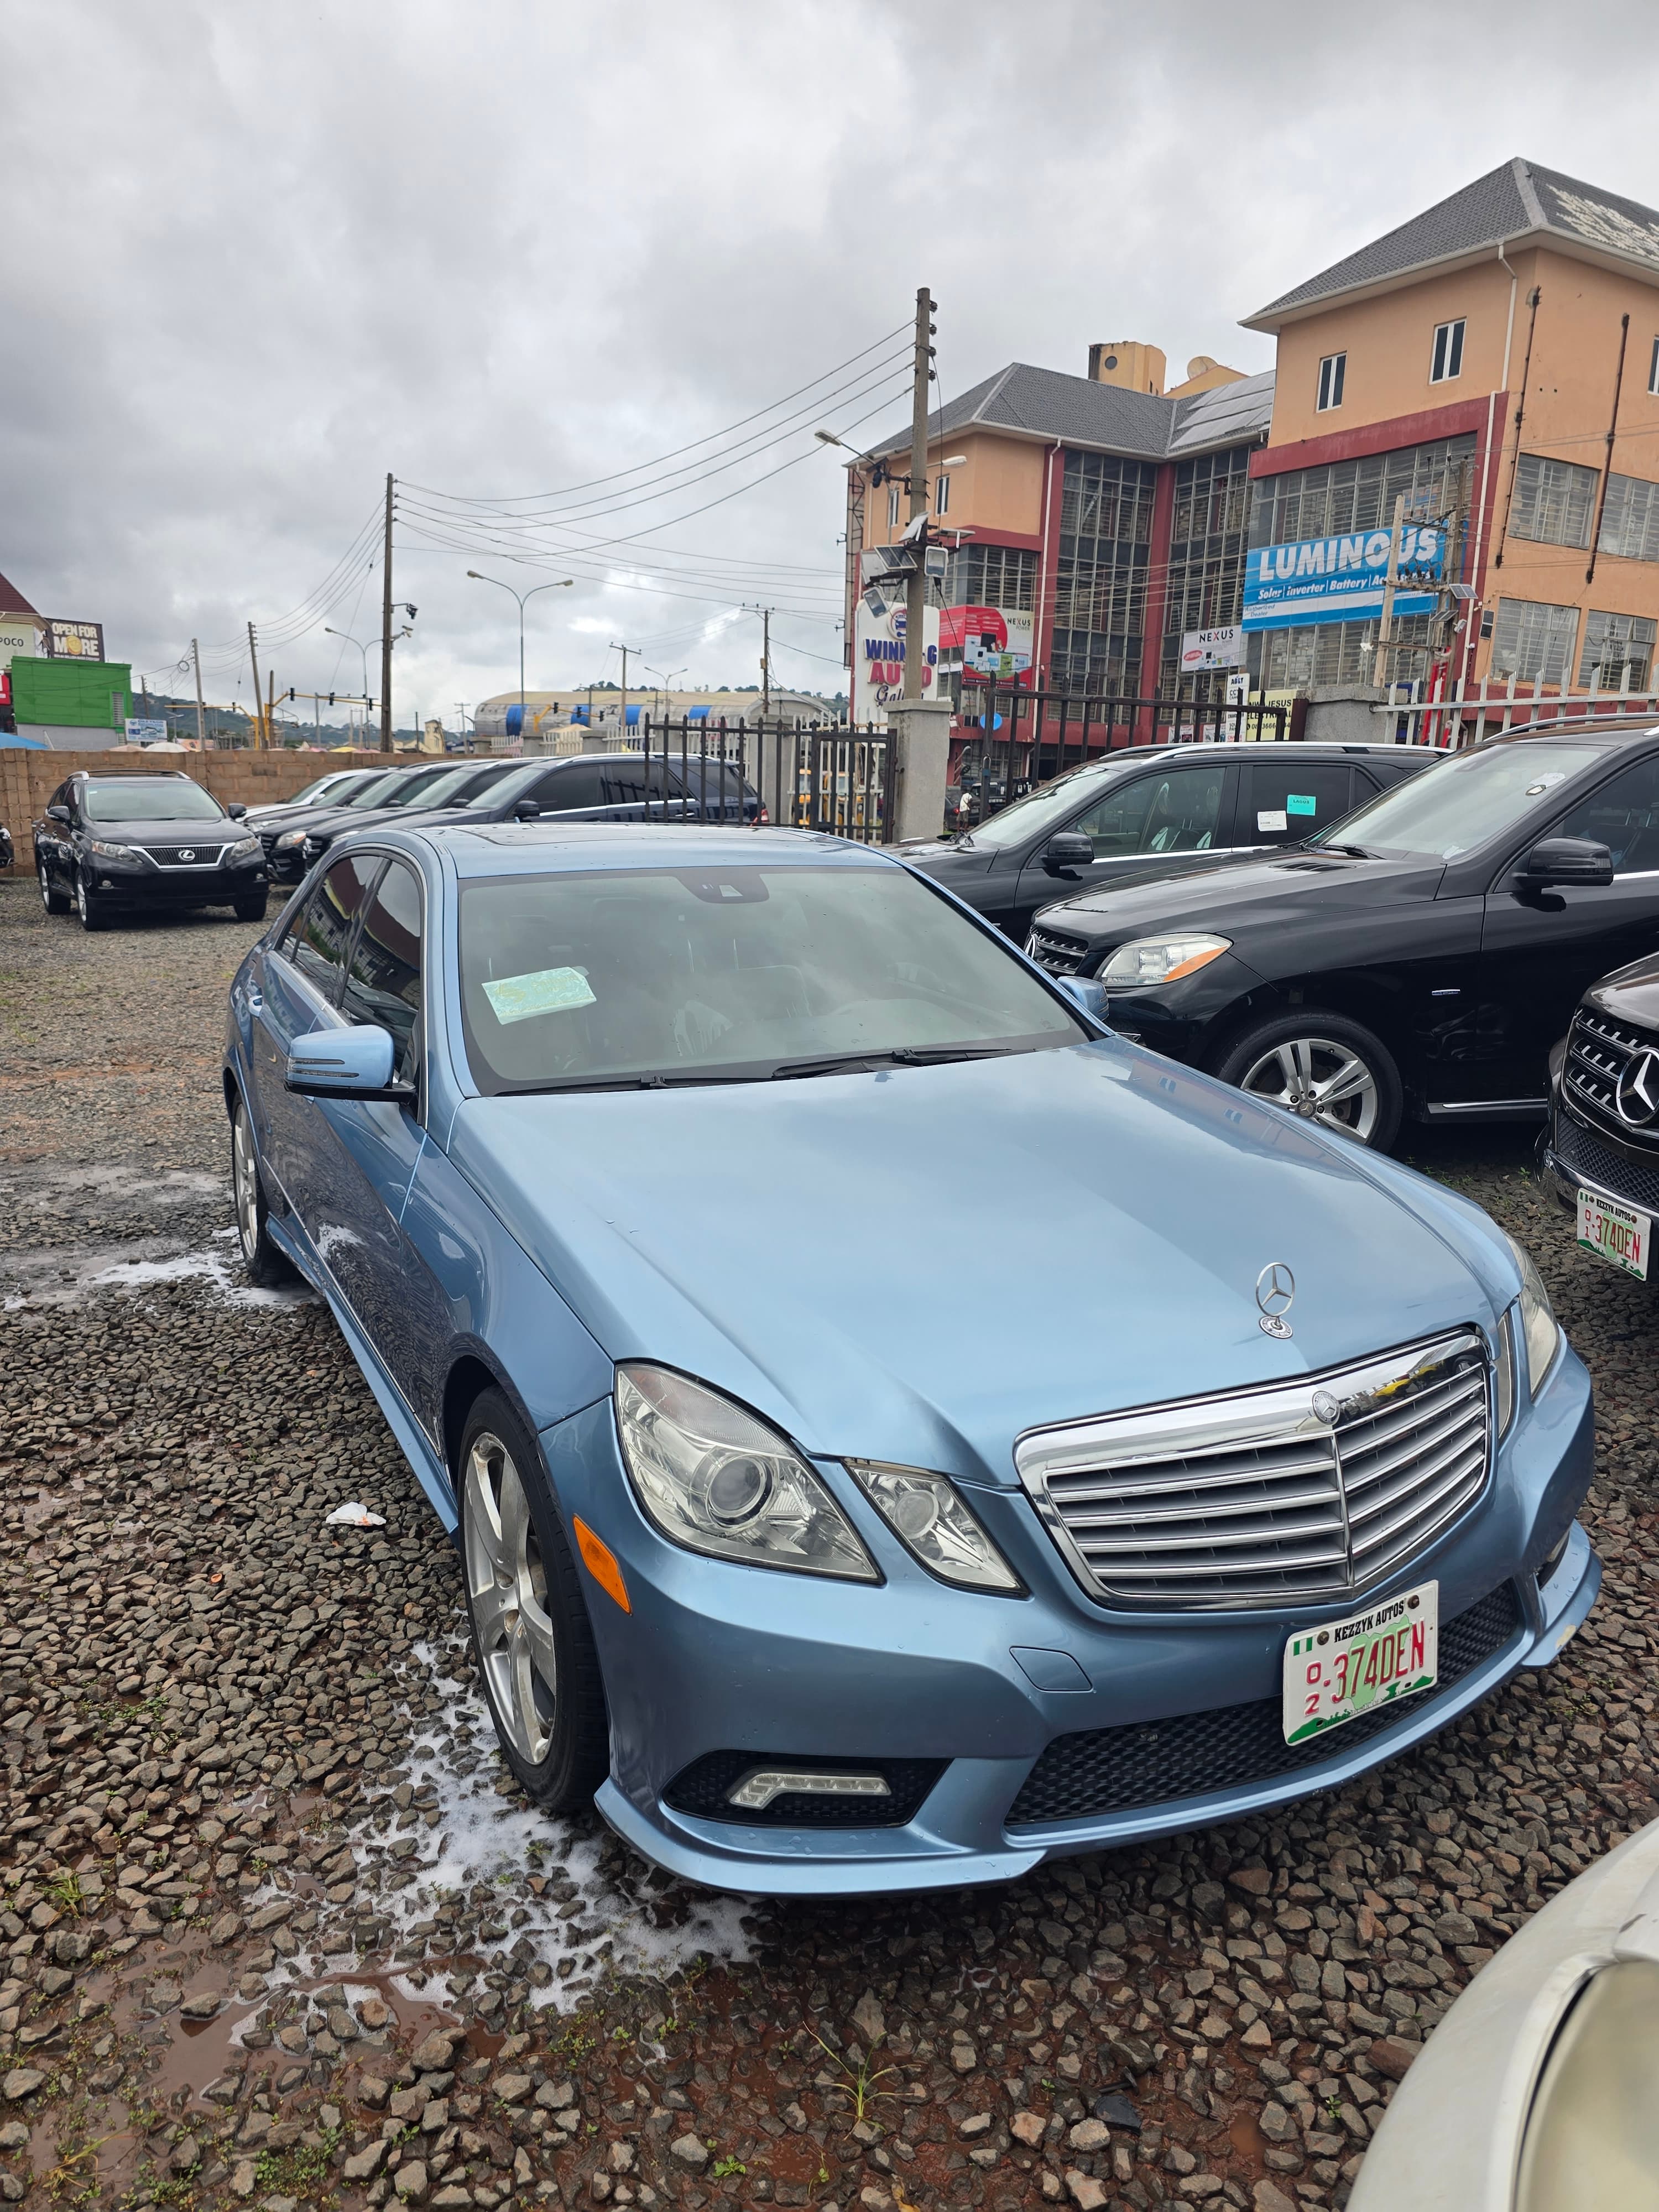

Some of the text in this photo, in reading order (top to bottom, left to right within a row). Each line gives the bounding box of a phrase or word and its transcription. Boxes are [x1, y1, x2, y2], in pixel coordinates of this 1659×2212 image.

[1259, 528, 1438, 582] LUMINOUS
[1258, 588, 1282, 600] Solar
[1329, 579, 1369, 591] Battery
[52, 622, 98, 639] OPEN FOR
[1007, 618, 1031, 627] NEXUS
[1199, 629, 1234, 643] NEXUS
[870, 662, 932, 688] AUO
[1596, 1198, 1631, 1222] KEZZYK AUTOS
[1334, 1599, 1405, 1643] KEZZYK AUTOS
